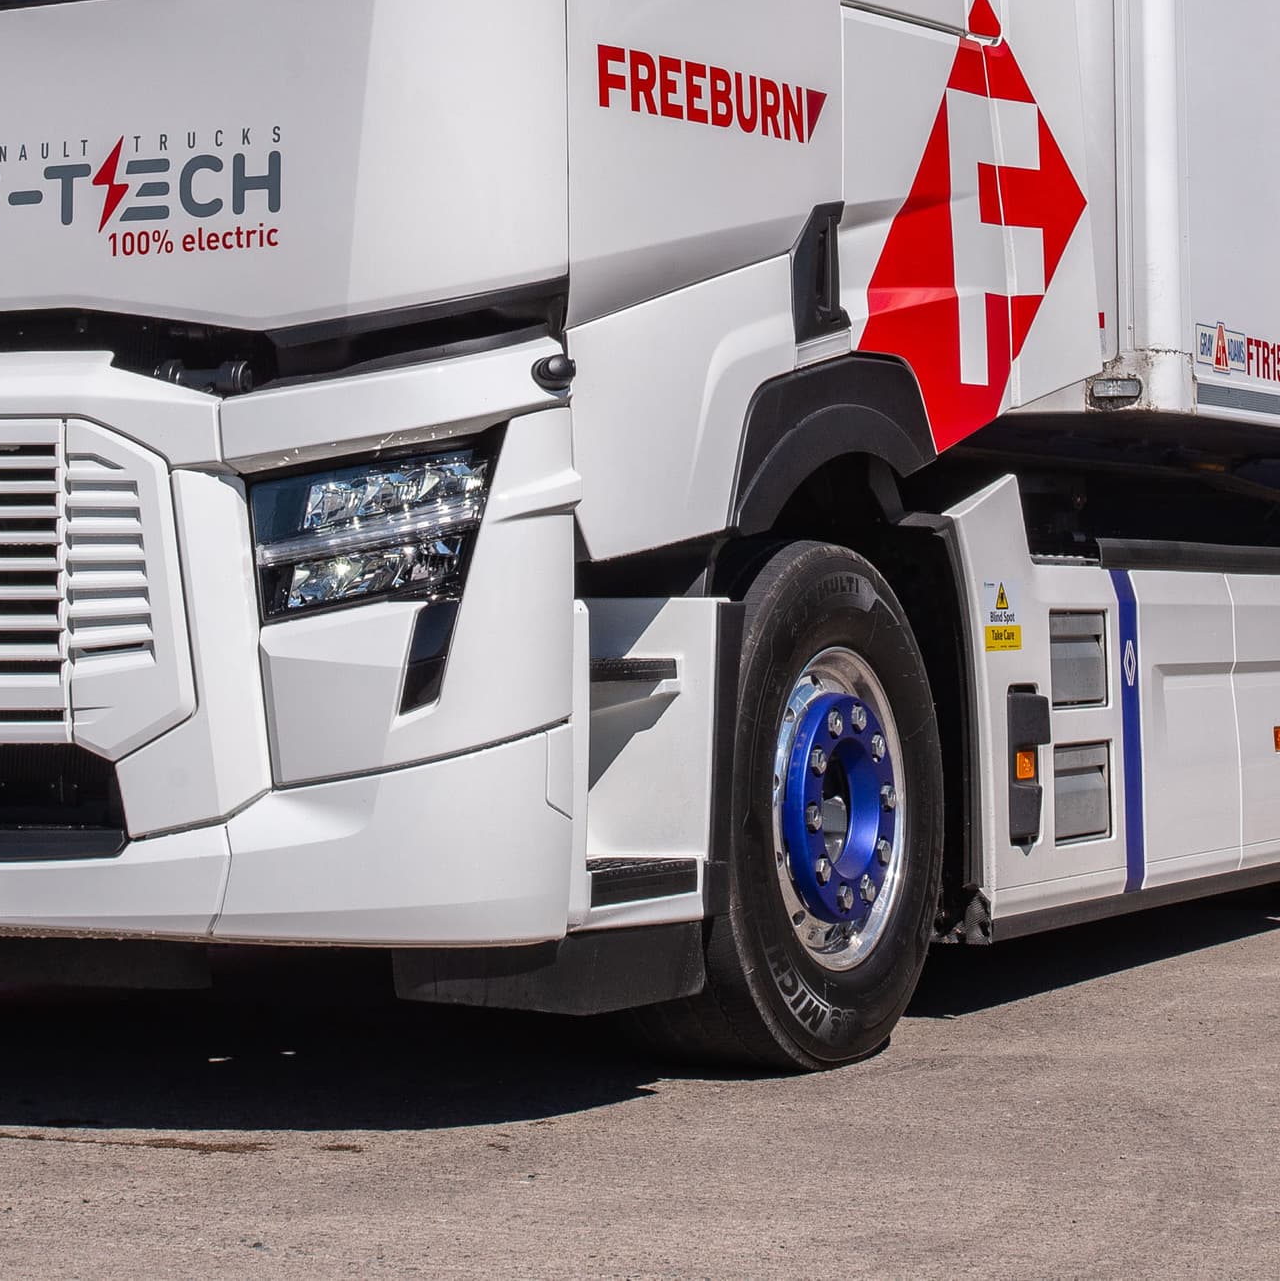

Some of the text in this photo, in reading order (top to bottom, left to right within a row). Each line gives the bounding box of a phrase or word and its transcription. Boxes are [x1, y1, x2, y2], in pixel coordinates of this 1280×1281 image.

[598, 44, 805, 143] FREEBURN
[133, 126, 282, 153] TRUCKS
[108, 223, 279, 257] 100% electric
[990, 610, 1015, 625] Blind Spot
[991, 629, 1003, 640] Take
